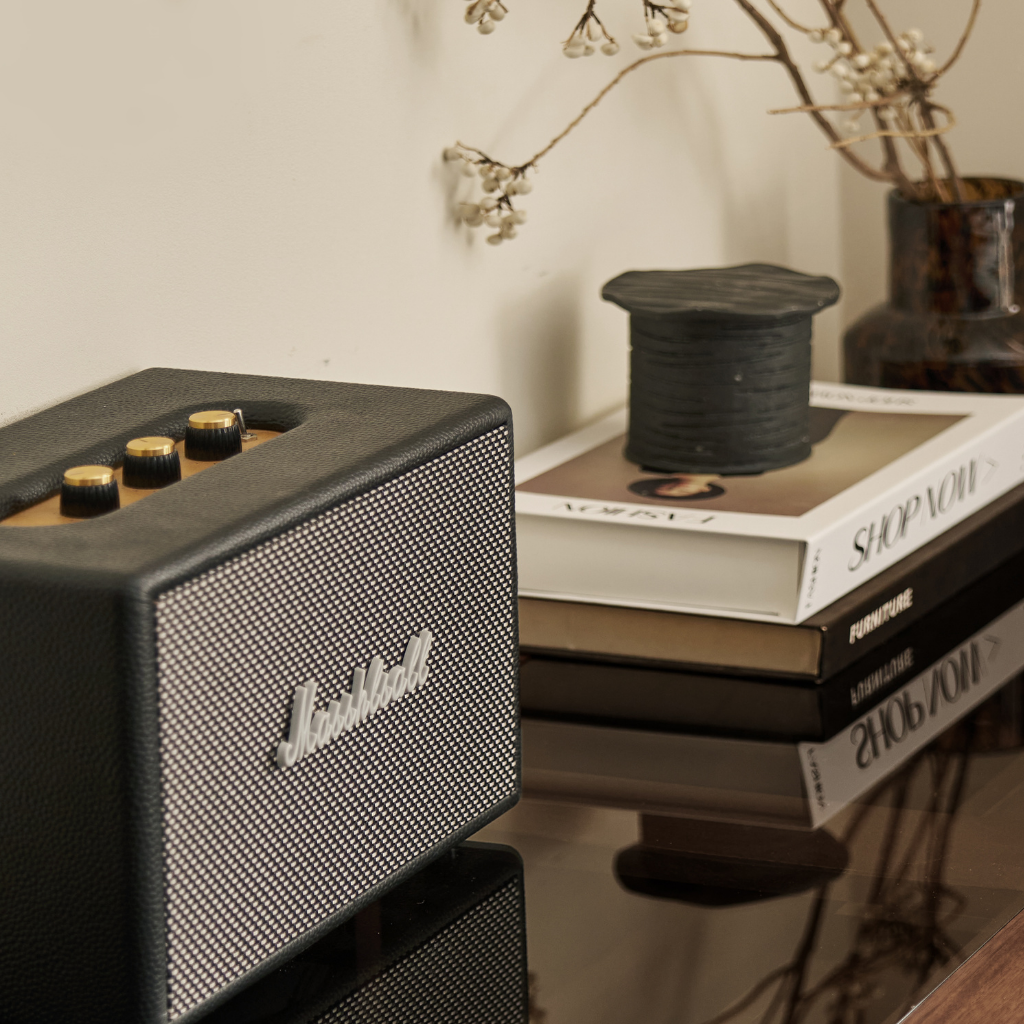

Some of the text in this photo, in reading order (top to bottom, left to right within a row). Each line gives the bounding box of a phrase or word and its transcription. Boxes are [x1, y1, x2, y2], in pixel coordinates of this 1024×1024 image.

[848, 453, 985, 572] SHOP NOW
[849, 587, 914, 644] FURNITURE
[277, 630, 433, 767] Marshall
